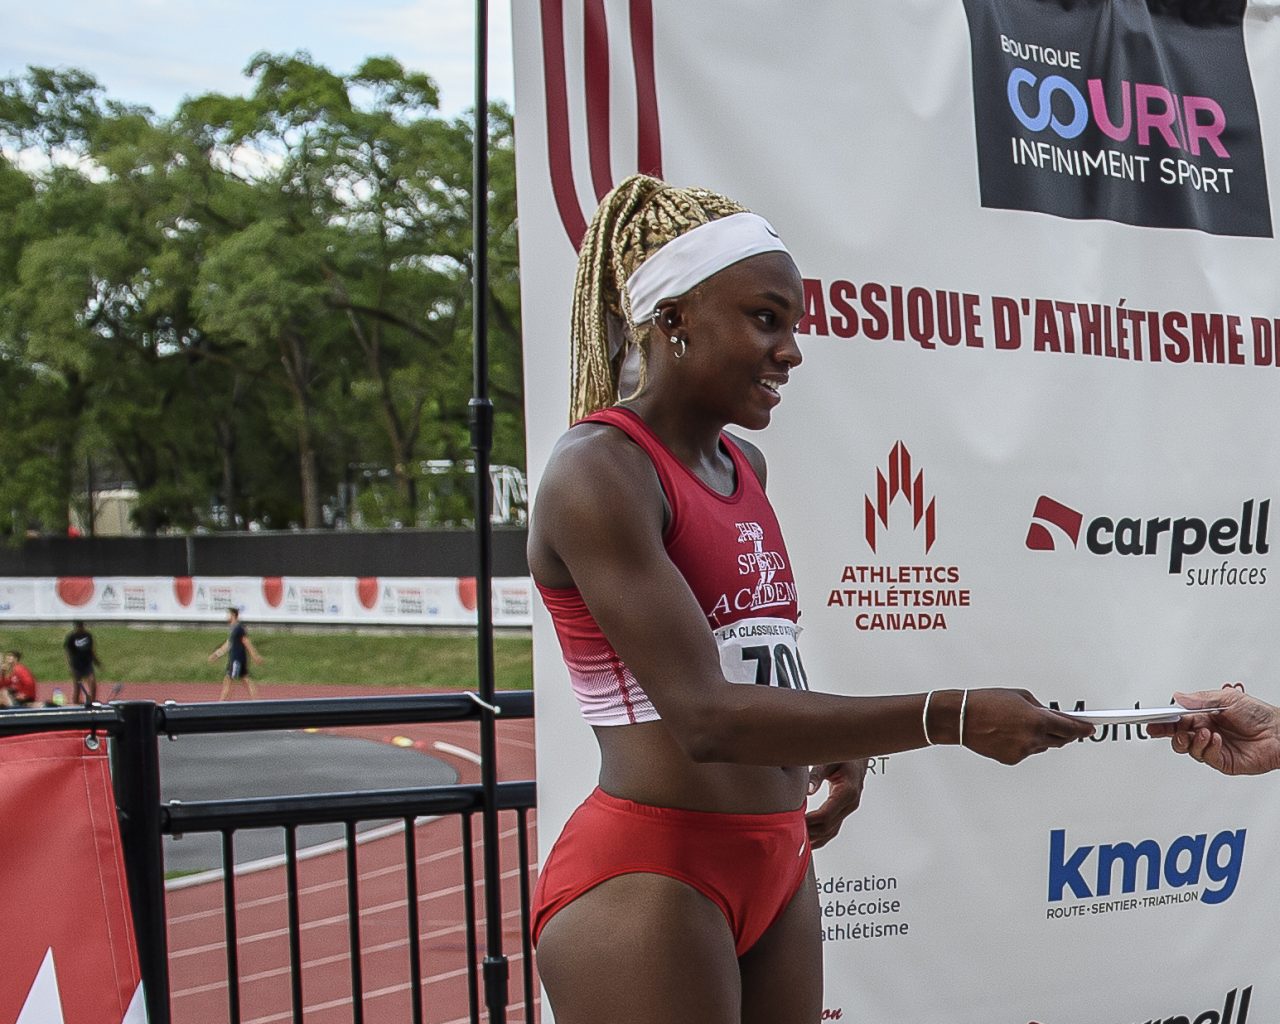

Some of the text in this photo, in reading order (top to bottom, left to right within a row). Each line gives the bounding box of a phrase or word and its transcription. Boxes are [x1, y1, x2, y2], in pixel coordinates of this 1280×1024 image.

[1000, 34, 1081, 70] BOUTIQUE
[1006, 67, 1230, 158] COURIR
[1011, 137, 1234, 195] INFINIMENT SPORT
[797, 278, 984, 350] ASSIQUE
[991, 296, 1246, 366] D'ATHLÉTISME
[1086, 498, 1271, 575] carpell
[841, 566, 959, 583] ATHLETICS
[1186, 561, 1267, 586] surfaces
[827, 586, 970, 607] ATHLÉTISME
[855, 613, 947, 630] CANADA
[722, 629, 737, 641] LA
[1048, 828, 1247, 905] kmag
[816, 875, 897, 894] édération
[820, 898, 900, 918] ébécoise
[821, 922, 909, 941] athlétisme
